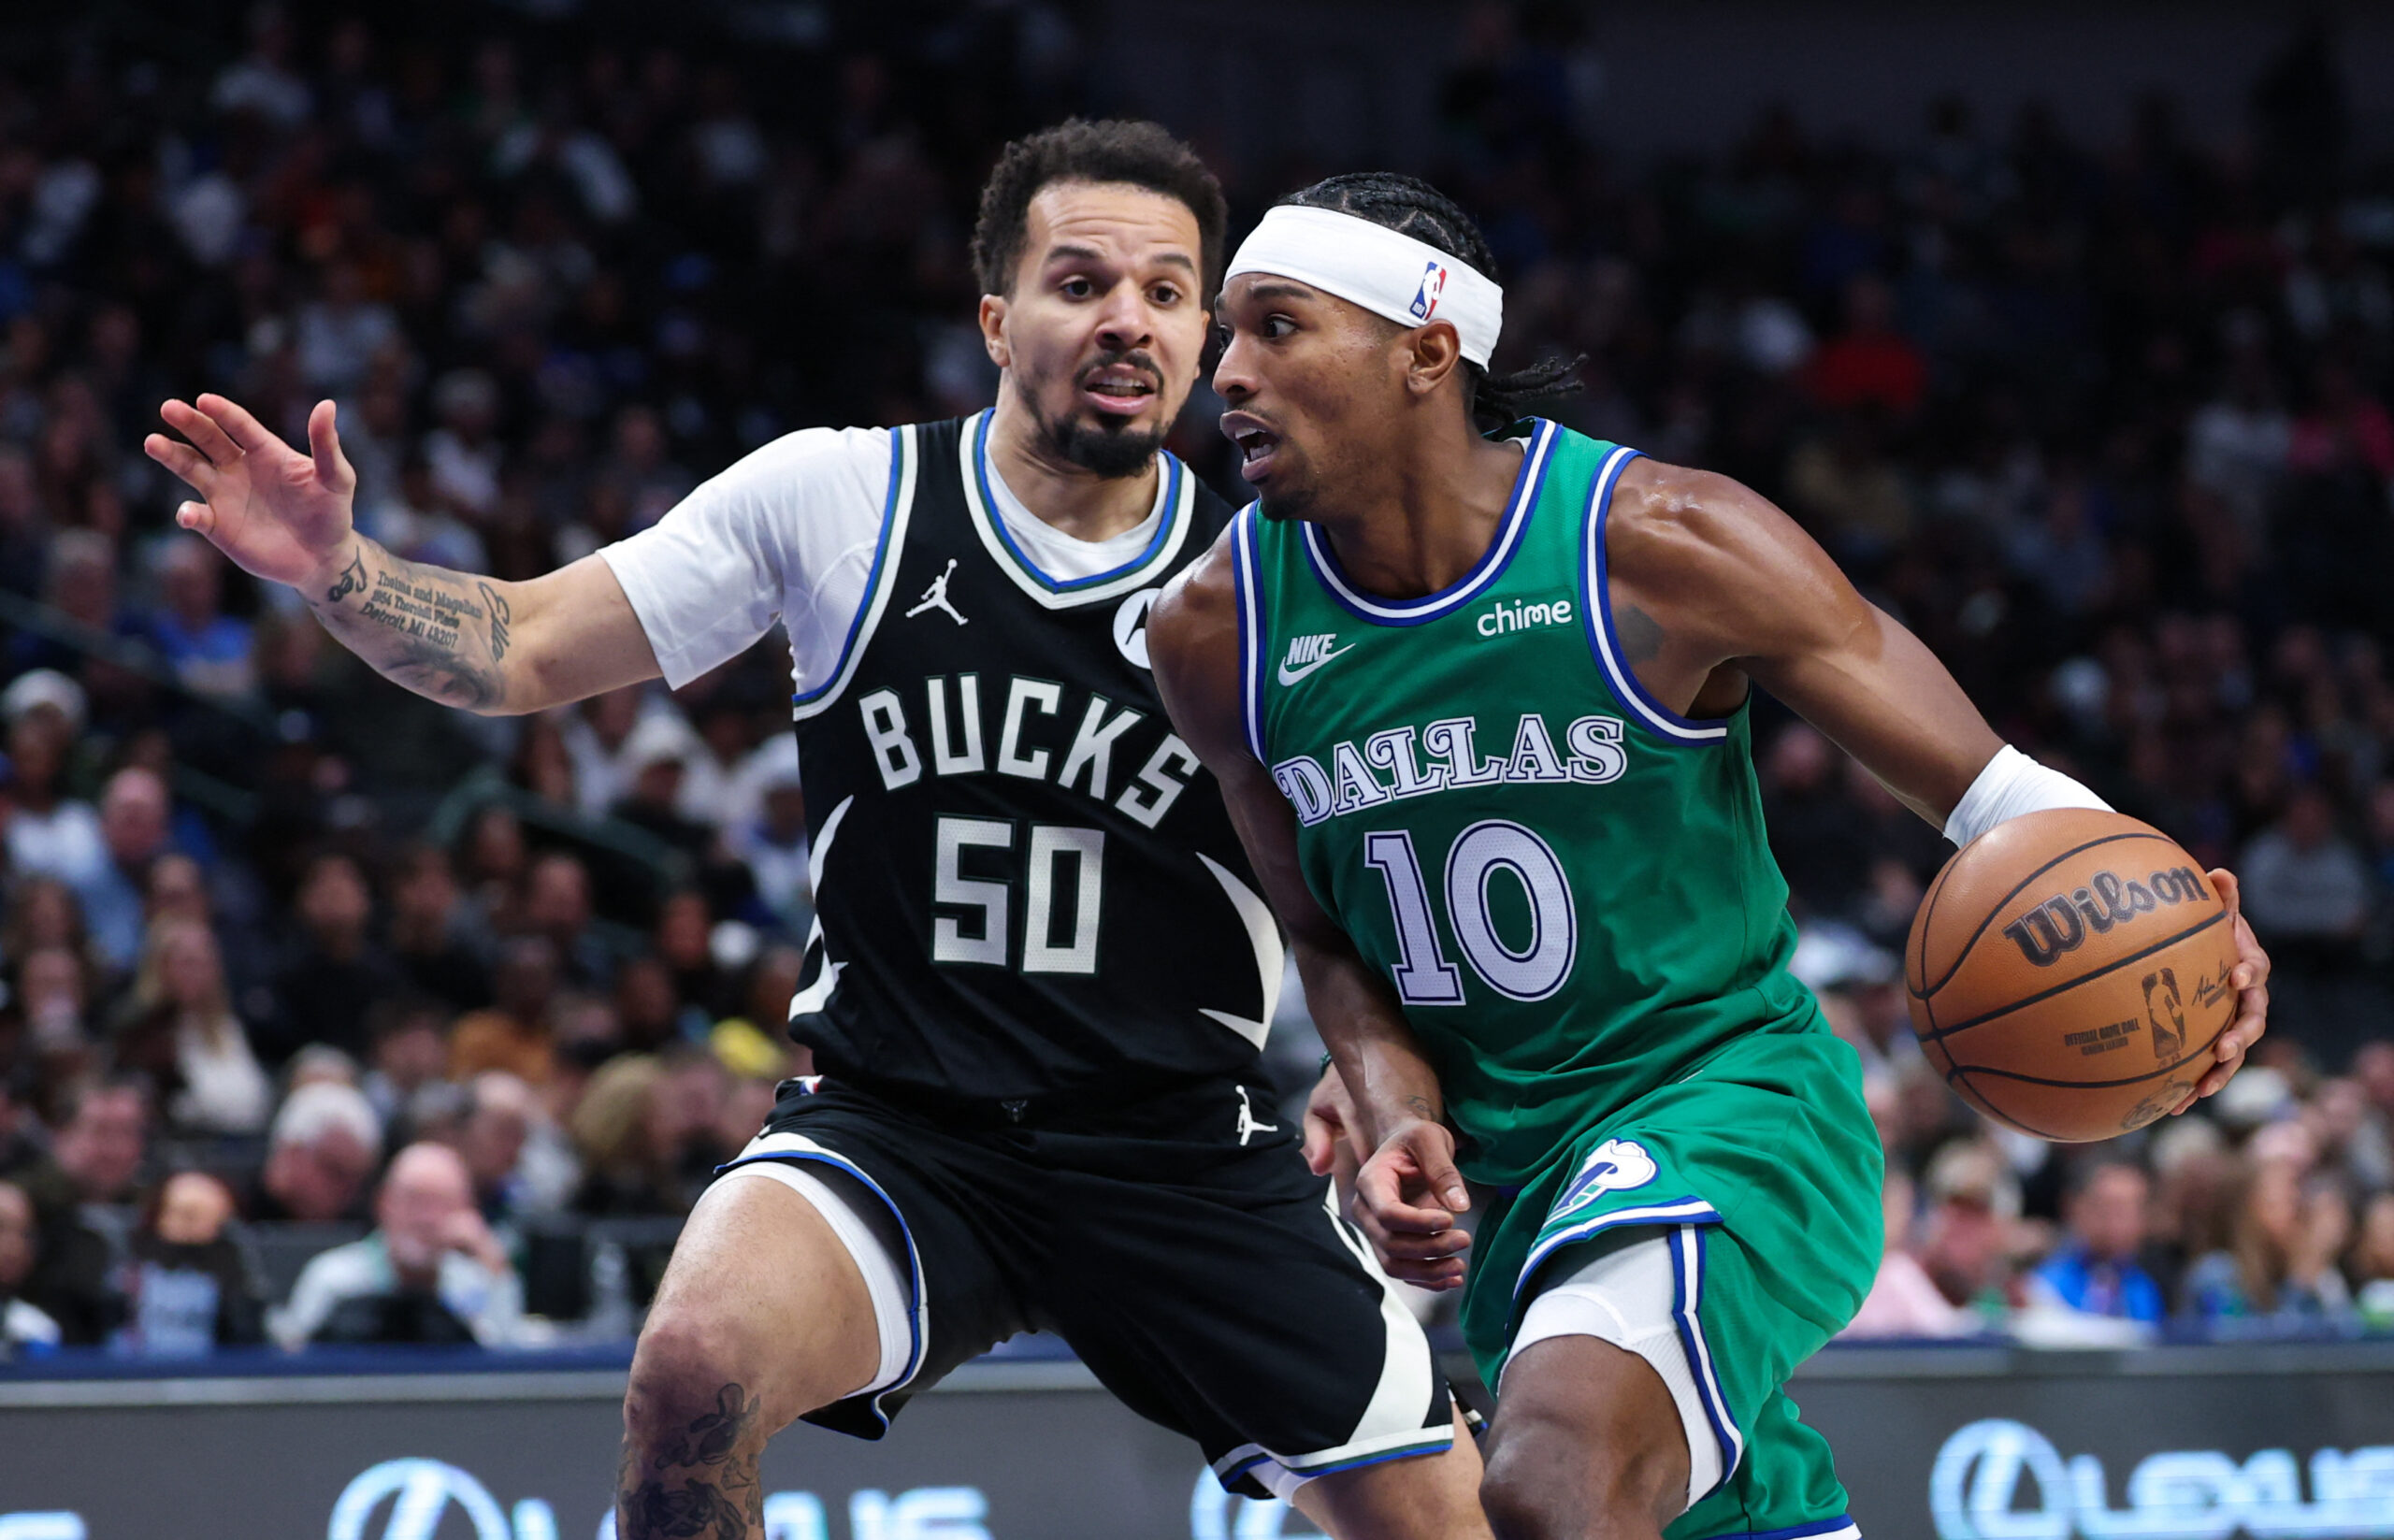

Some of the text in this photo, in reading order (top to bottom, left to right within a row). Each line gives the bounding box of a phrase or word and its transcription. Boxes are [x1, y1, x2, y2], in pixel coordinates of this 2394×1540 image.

[408, 617, 425, 638] MI
[413, 586, 433, 605] and
[1477, 599, 1572, 637] chime
[1285, 632, 1337, 666] NIKE
[858, 671, 1203, 830] BUCKS
[1272, 713, 1628, 828] DALLAS
[930, 812, 1106, 978] 50
[1363, 819, 1578, 1007] 10
[2002, 866, 2211, 967] Wilson
